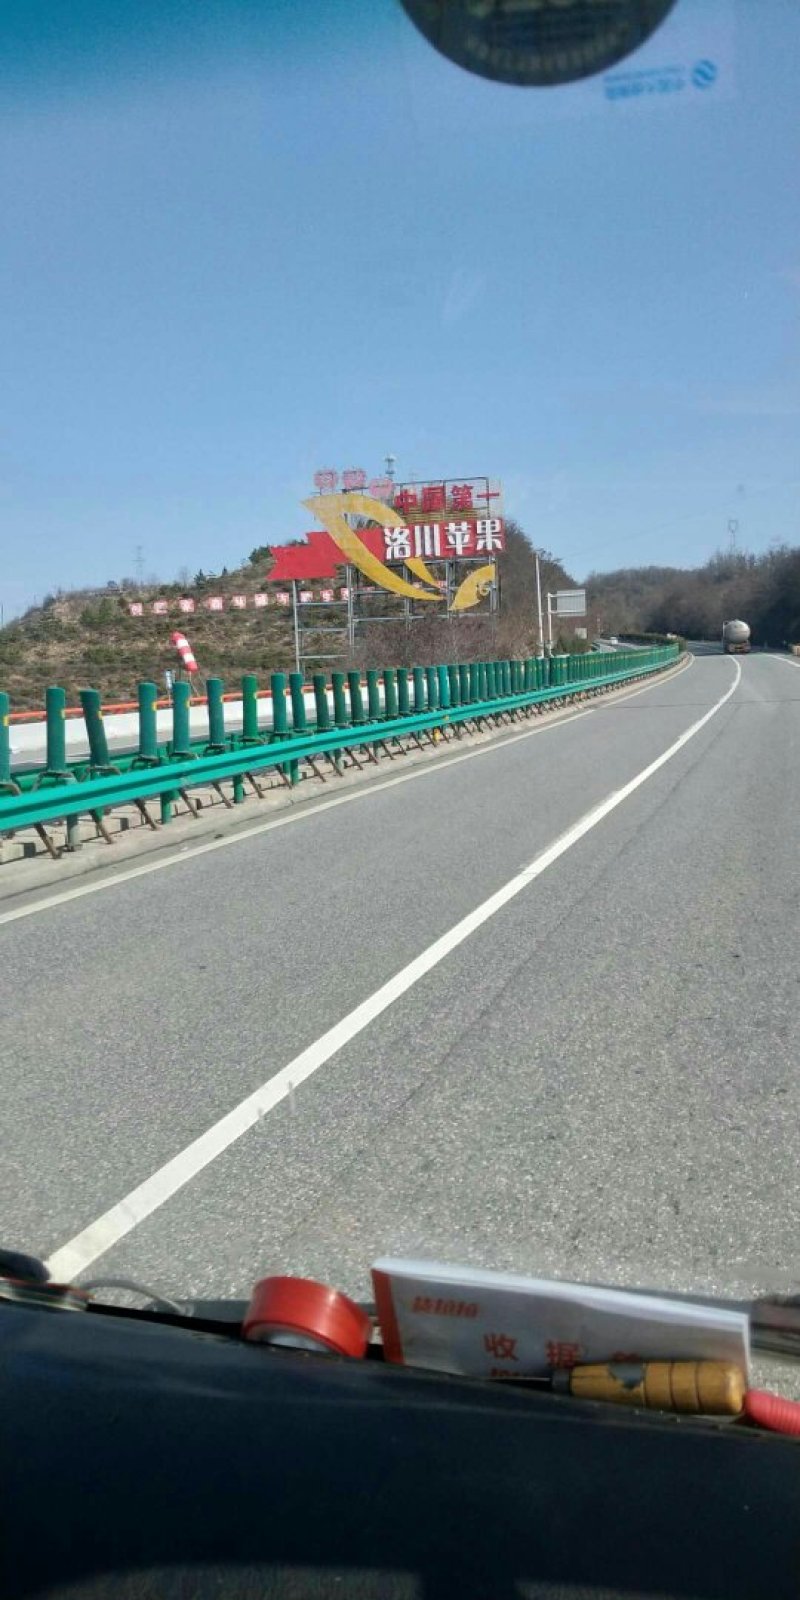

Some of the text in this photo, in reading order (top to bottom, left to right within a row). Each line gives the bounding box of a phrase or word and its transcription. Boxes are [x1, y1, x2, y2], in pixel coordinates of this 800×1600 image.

[394, 485, 500, 515] 中国第一
[384, 519, 503, 560] 洛川苹果
